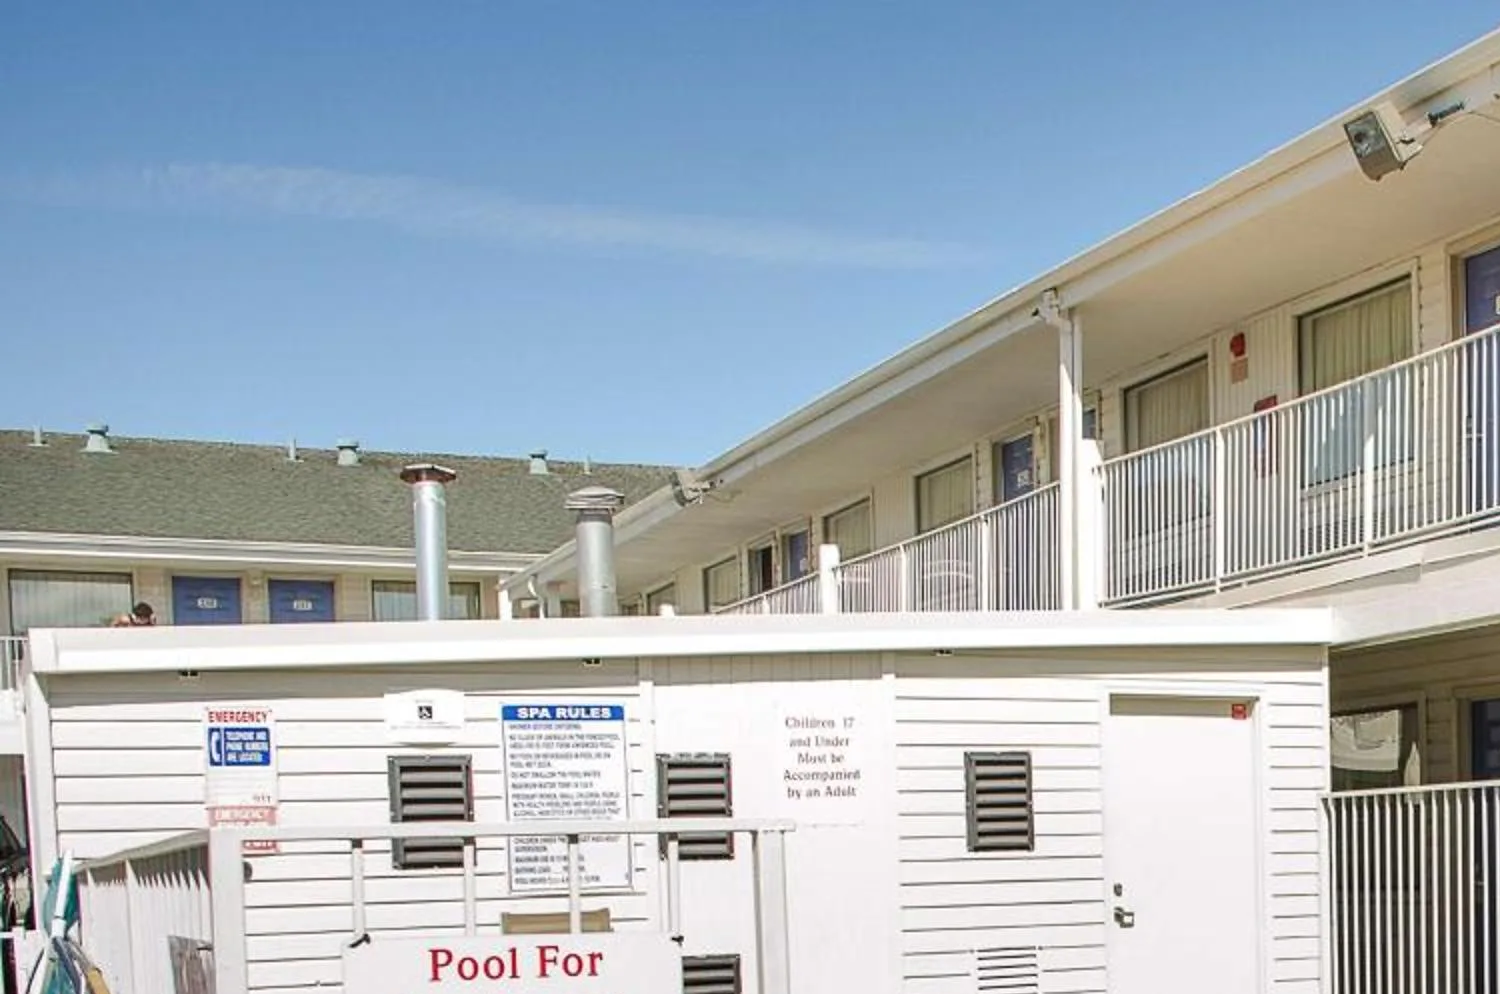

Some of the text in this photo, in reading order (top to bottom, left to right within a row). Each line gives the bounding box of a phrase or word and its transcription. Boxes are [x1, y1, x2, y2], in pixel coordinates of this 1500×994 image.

[208, 711, 268, 723] EMERGENCY
[517, 707, 612, 719] SPA RULES
[785, 716, 856, 729] Children 17
[789, 735, 849, 748] and Under
[798, 752, 845, 764] Must be
[784, 769, 861, 782] Accompanied
[787, 785, 857, 799] by an Adult
[428, 945, 603, 982] Pool For
